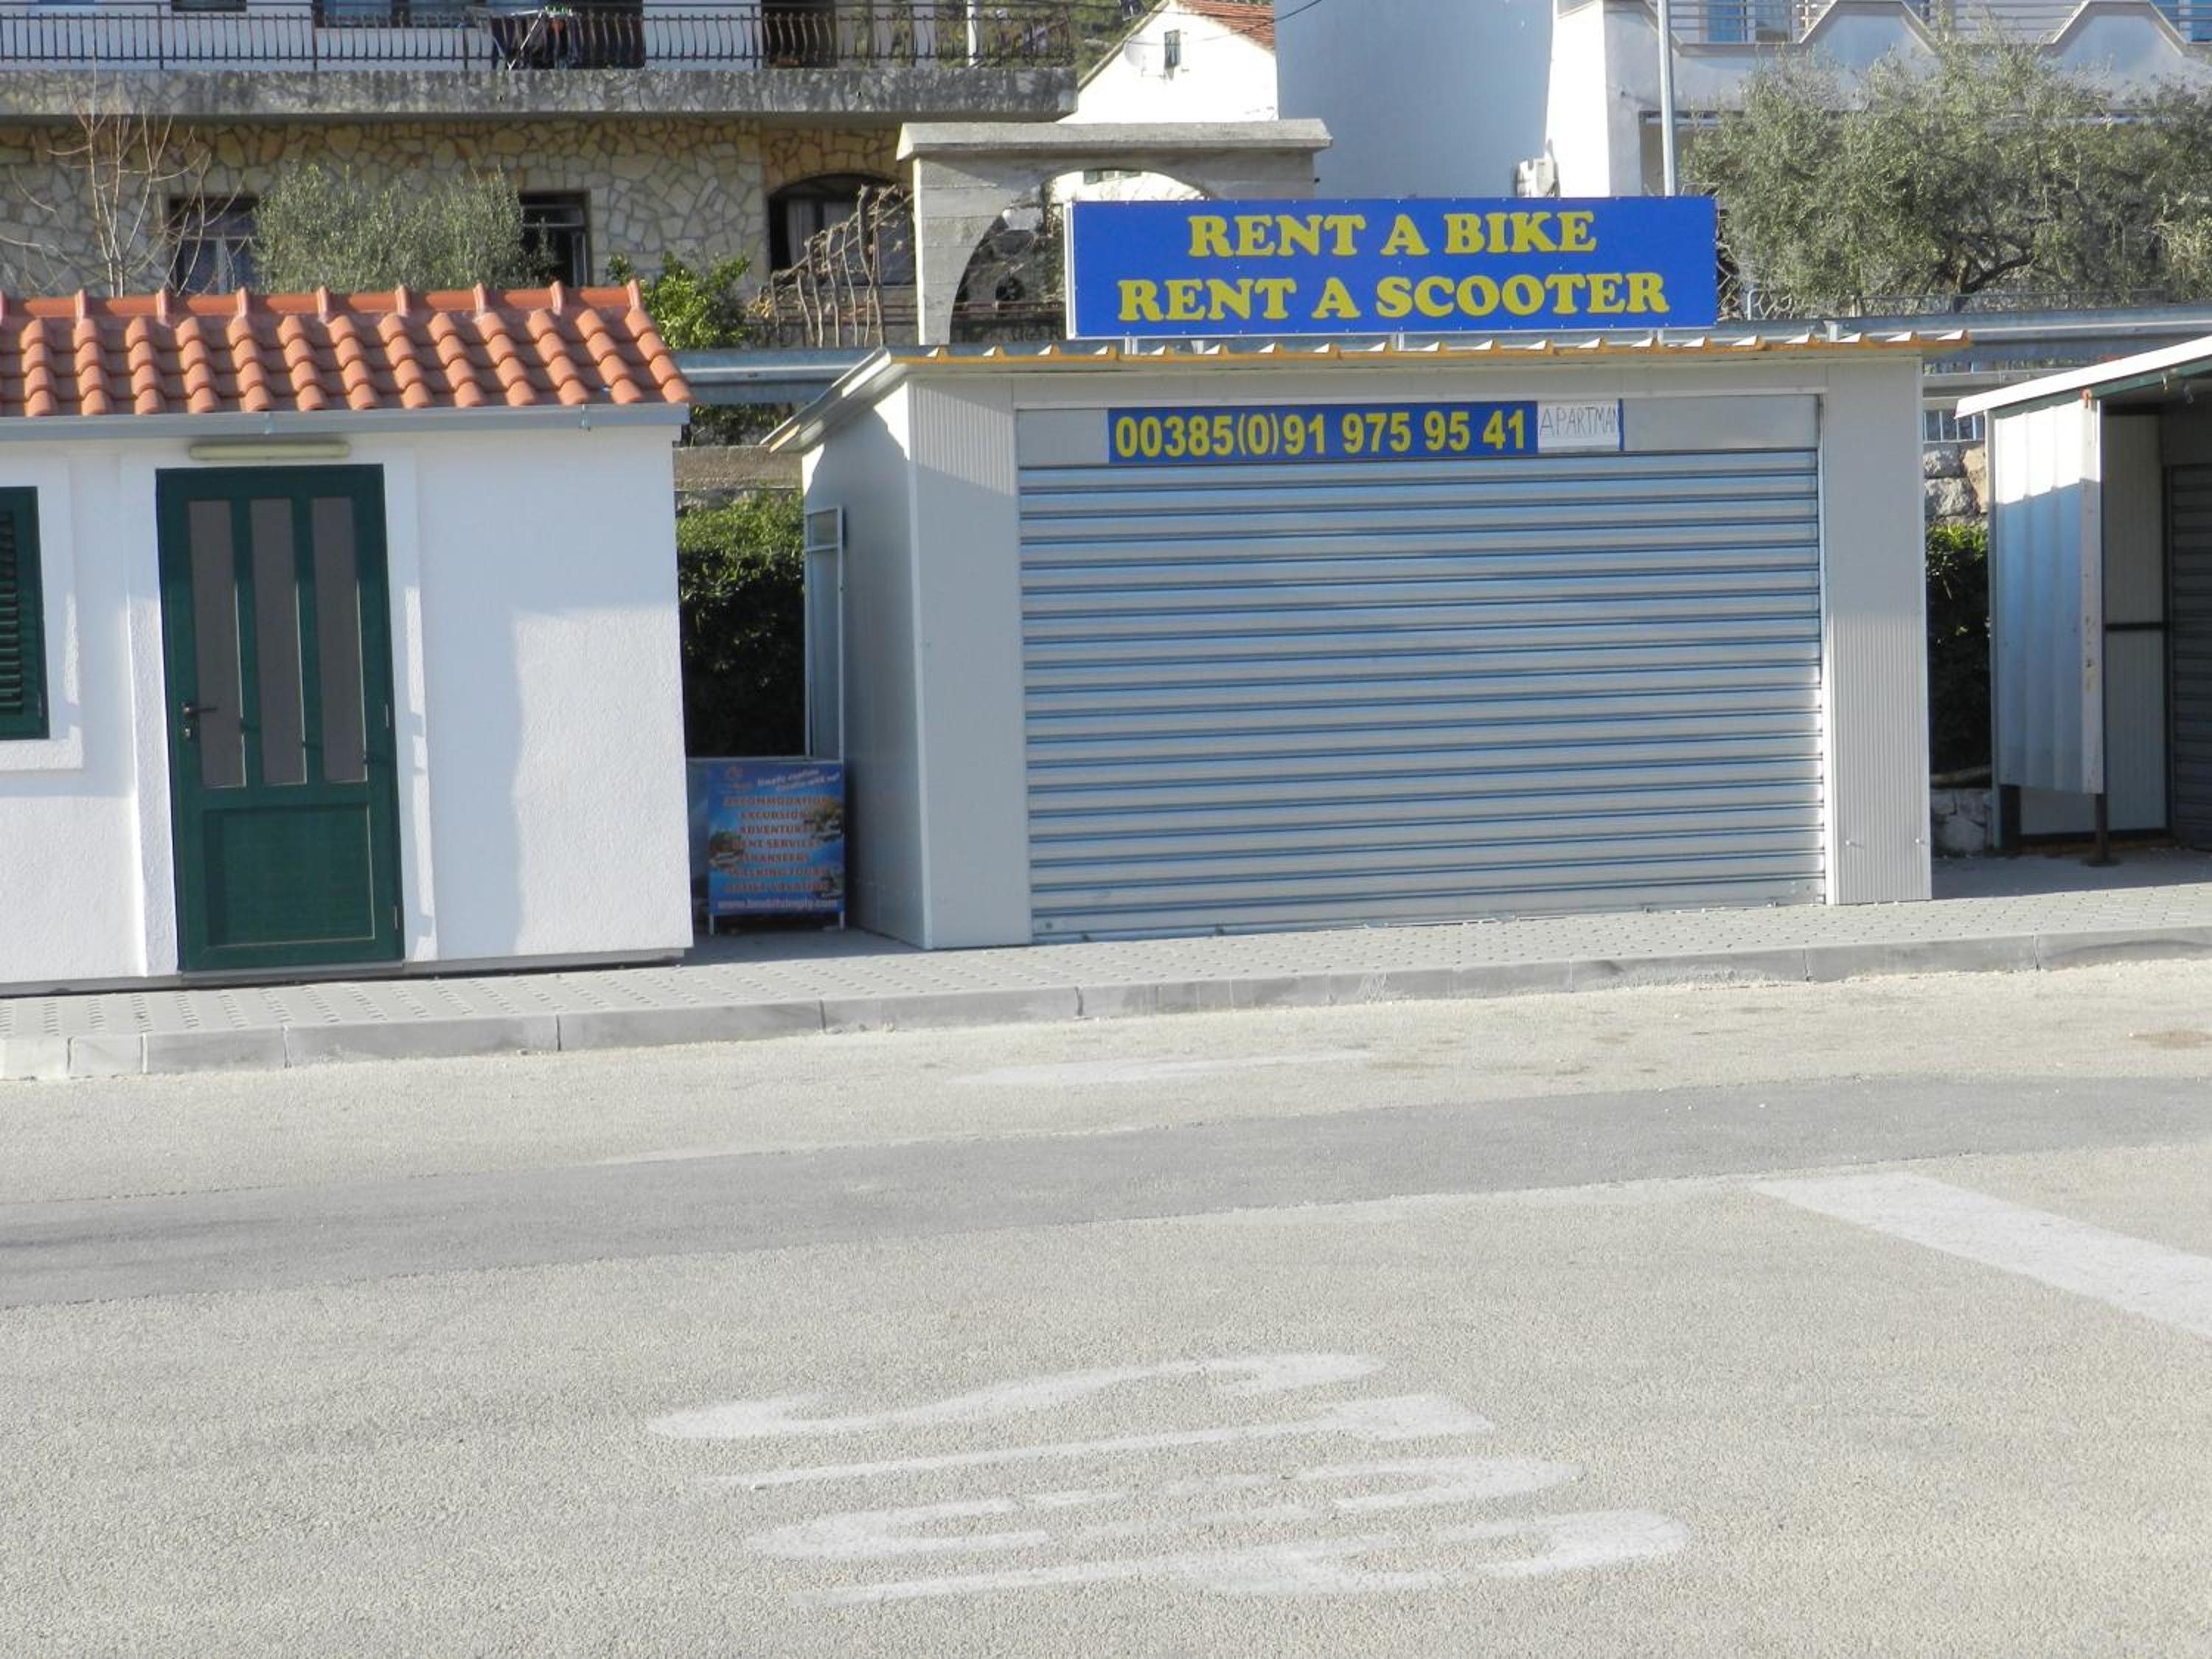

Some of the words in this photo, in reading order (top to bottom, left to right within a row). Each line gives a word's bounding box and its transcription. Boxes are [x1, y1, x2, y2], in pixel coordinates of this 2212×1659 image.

[1189, 215, 1366, 257] RENT
[1380, 215, 1429, 256] A
[1444, 211, 1597, 254] BIKE
[1118, 278, 1297, 322] RENT
[1312, 277, 1360, 319] A
[1376, 272, 1669, 319] SCOOTER
[1115, 414, 1326, 459] 00385(0)91
[1340, 411, 1412, 454] 975
[1422, 411, 1471, 453] 95
[1481, 409, 1525, 450] 41
[641, 1351, 1690, 1609] STOP
